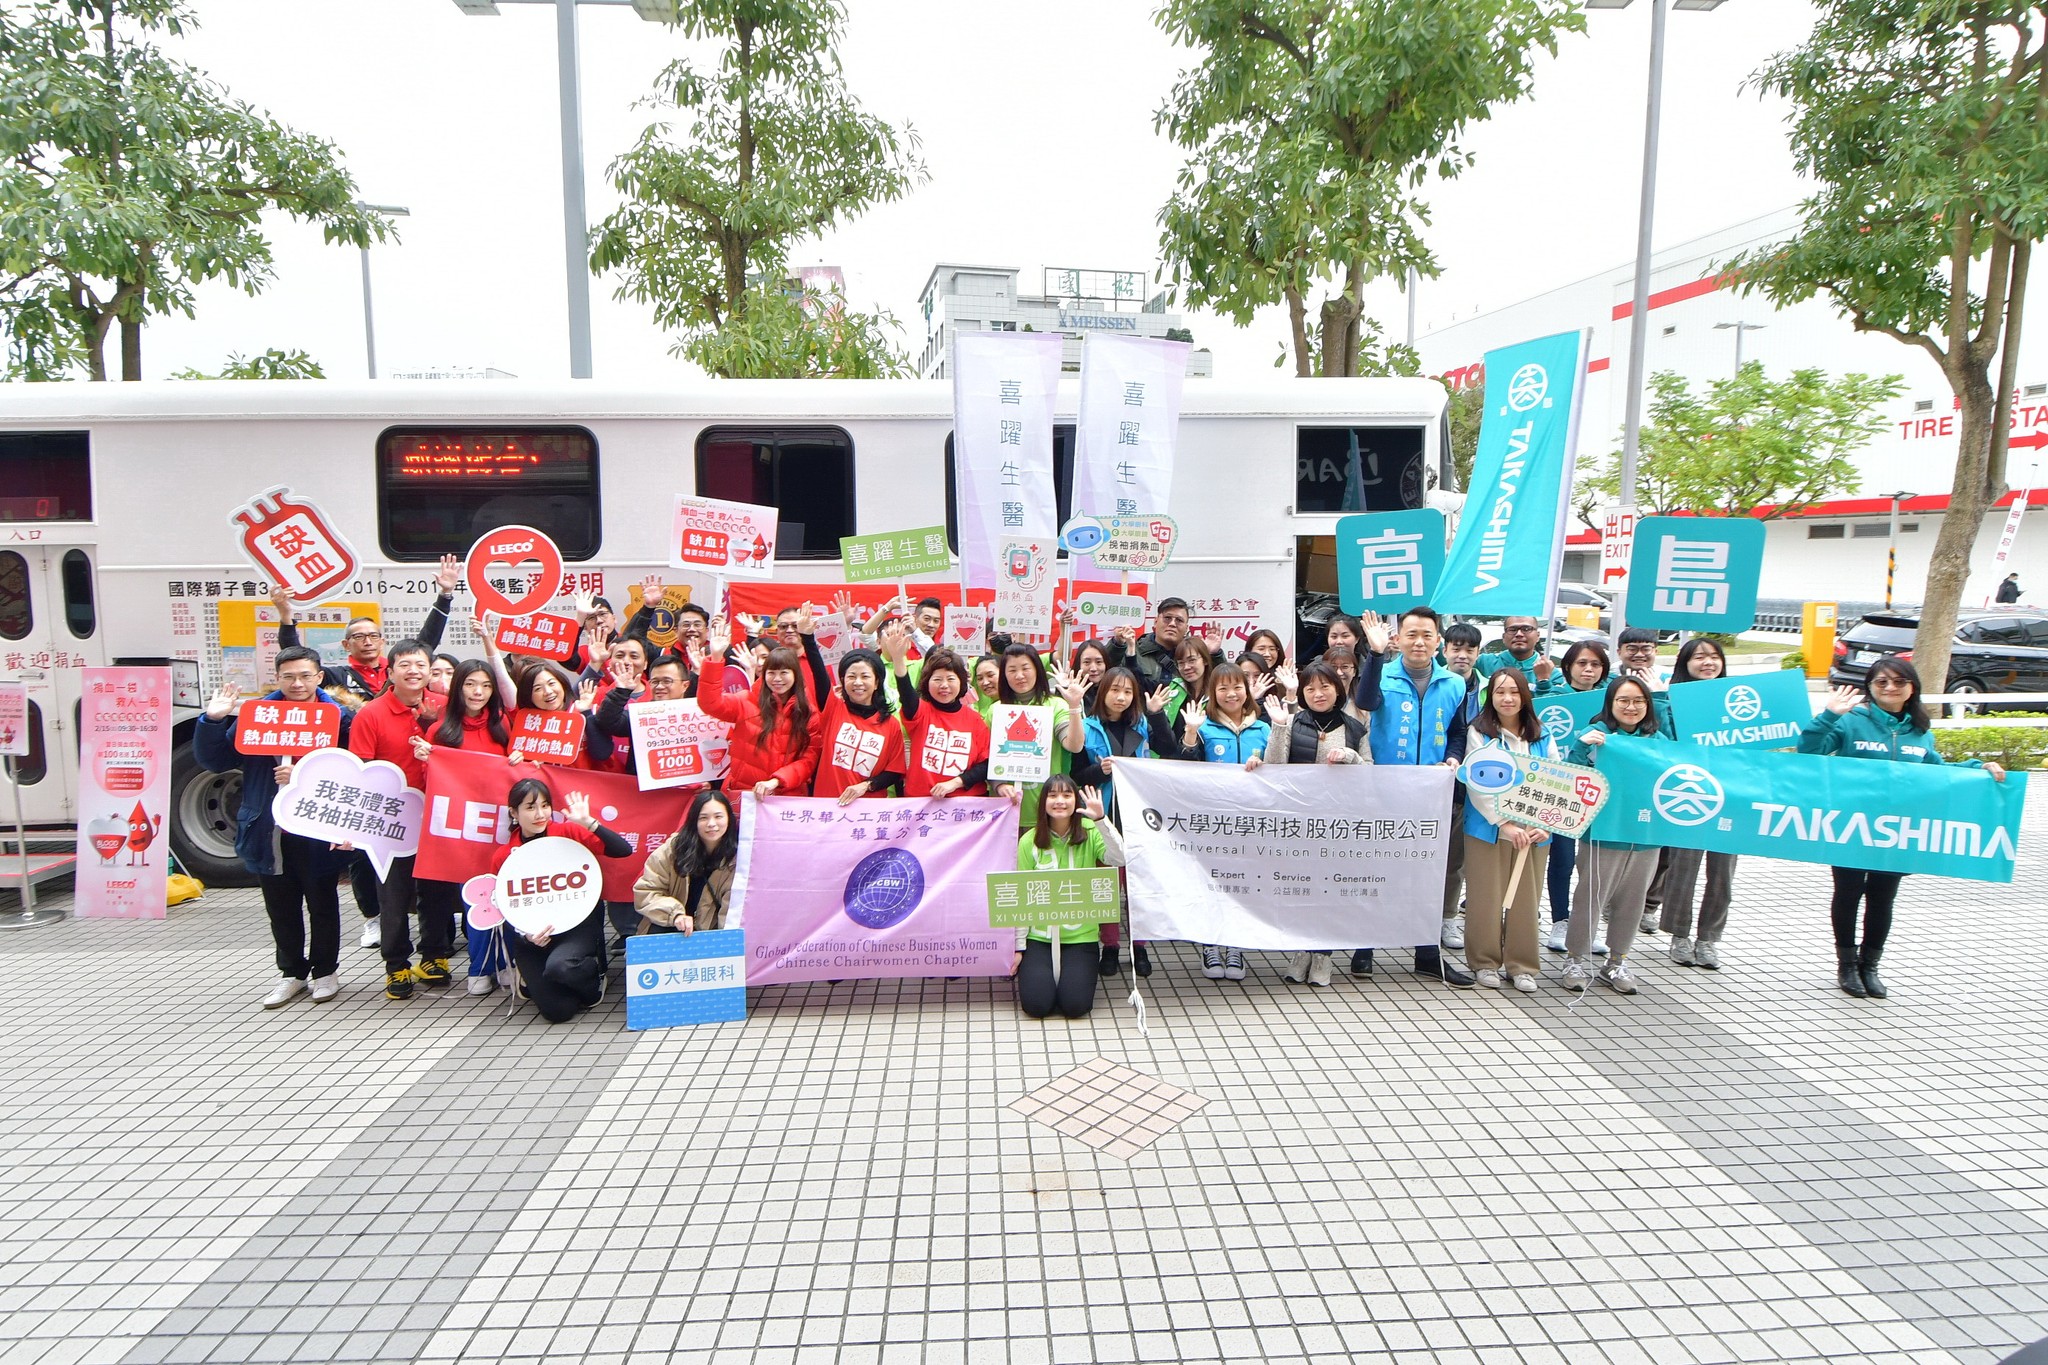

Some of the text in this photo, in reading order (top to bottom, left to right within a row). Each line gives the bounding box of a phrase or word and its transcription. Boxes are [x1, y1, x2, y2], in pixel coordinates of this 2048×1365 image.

[1071, 315, 1136, 330] MEISSEN
[1442, 363, 1485, 392] STC
[1899, 416, 1953, 440] TIRE
[998, 379, 1024, 528] 喜躍生醫
[1472, 419, 1534, 594] TAKASHIMA
[9, 528, 42, 540] 入口
[1605, 513, 1632, 538] 出口
[269, 524, 335, 585] 缺血
[490, 541, 534, 555] LEECO
[846, 533, 945, 566] 喜躍生醫
[1109, 541, 1160, 552] 挽袖捐熱血
[1605, 543, 1629, 558] EXIT
[850, 559, 948, 578] XI YUE BIOMEDICINE
[1356, 528, 1423, 600] 高
[1652, 535, 1730, 614] 島
[168, 581, 269, 597] 國際獅子會3
[998, 591, 1033, 602] 捐熱血
[1013, 605, 1049, 616] 分享愛
[1097, 604, 1141, 618] 大學眼鏡
[1145, 598, 1259, 612] 台液基金會
[294, 612, 342, 622] 血資訊欄
[501, 630, 570, 654] 請熱血參與
[5, 652, 87, 669] 歡迎捐血
[254, 705, 323, 726] 缺血！
[523, 713, 573, 734] 缺血！
[242, 731, 332, 748] 熱血就是你
[841, 726, 880, 752] 捐血
[927, 731, 967, 748] 捐血
[1692, 721, 1803, 747] TAKASHIMA
[511, 737, 574, 757] 感謝你熱血
[1853, 741, 1889, 752] TAKA
[657, 754, 703, 769] 1000
[1540, 764, 1574, 780] 大學眼科
[1537, 776, 1571, 793] 大學眼鏡
[314, 779, 405, 817] 我愛禮客
[1518, 784, 1582, 813] 挽袖捐熱血
[293, 797, 407, 841] 挽袖捐熱血
[779, 808, 1005, 824] 世界華人工商婦女企管協會
[850, 824, 932, 841] 華董分會
[1167, 812, 1439, 840] 大學光學科技股份有限公司
[1752, 801, 2017, 862] TAKASHIMA
[1170, 841, 1436, 860] Universal Vision Biotechnology
[507, 871, 587, 897] LEECO
[1211, 868, 1386, 882] Expert Service Generation
[106, 881, 135, 889] LEECO
[994, 877, 1114, 908] 喜躍生醫
[1272, 887, 1310, 896] 公益服務
[1340, 887, 1379, 897] 世代溝通
[996, 909, 1118, 922] XI YUE BIOMEDICINE
[755, 942, 791, 958] Global
[848, 939, 861, 952] of
[862, 939, 906, 953] Chinese
[909, 938, 956, 952] Business
[958, 937, 998, 950] Women
[775, 954, 979, 969] Chinese Chairwomen Chapter
[664, 964, 735, 986] 大學眼科
